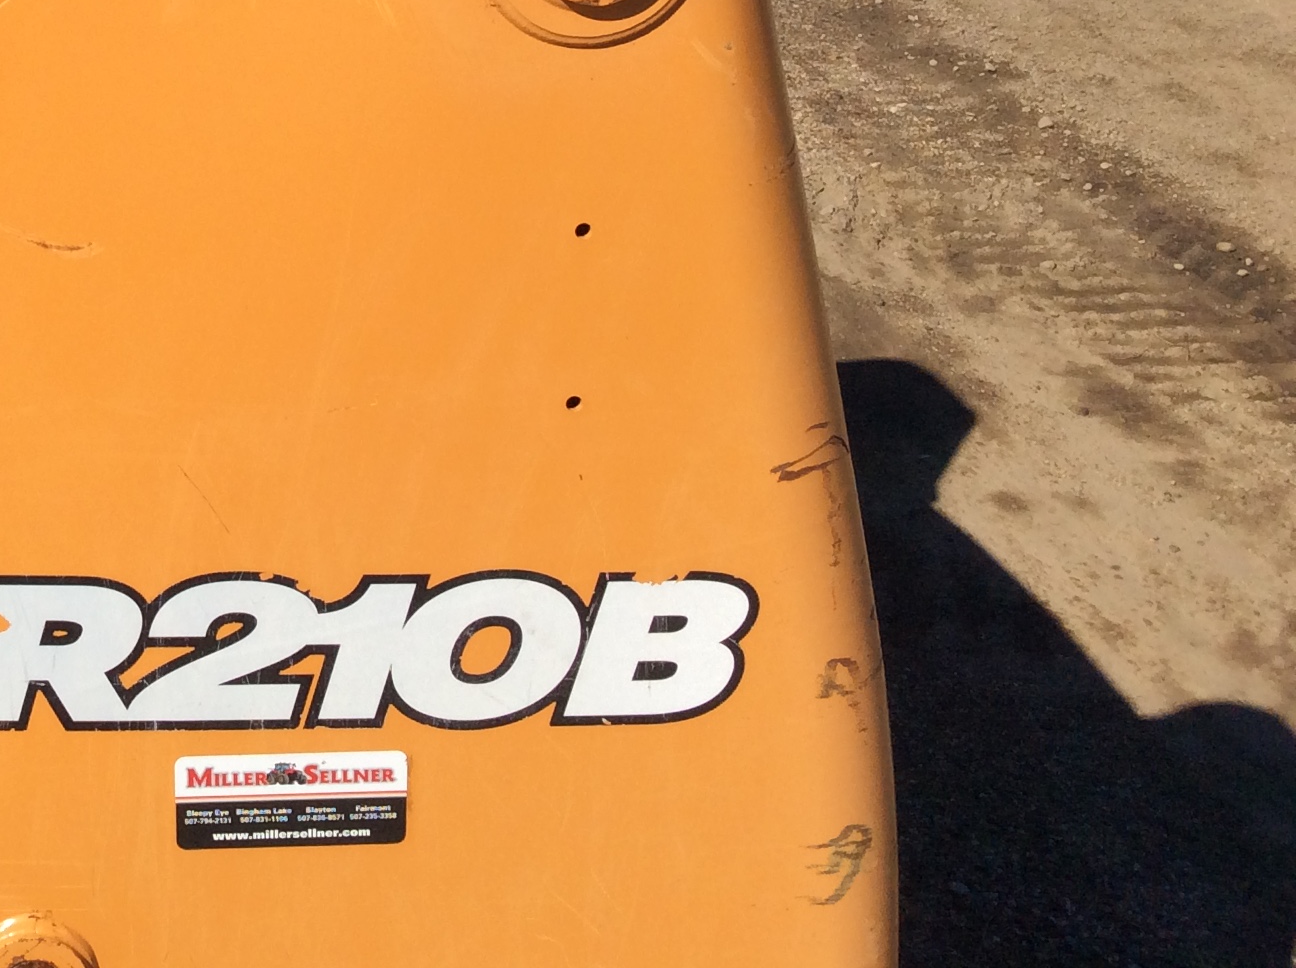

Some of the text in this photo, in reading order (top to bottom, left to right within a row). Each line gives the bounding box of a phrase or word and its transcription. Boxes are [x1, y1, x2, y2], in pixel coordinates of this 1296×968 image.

[186, 763, 396, 789] MILLER SELLNER
[273, 806, 293, 815] Lake
[212, 827, 371, 841] www.millersellner.com
